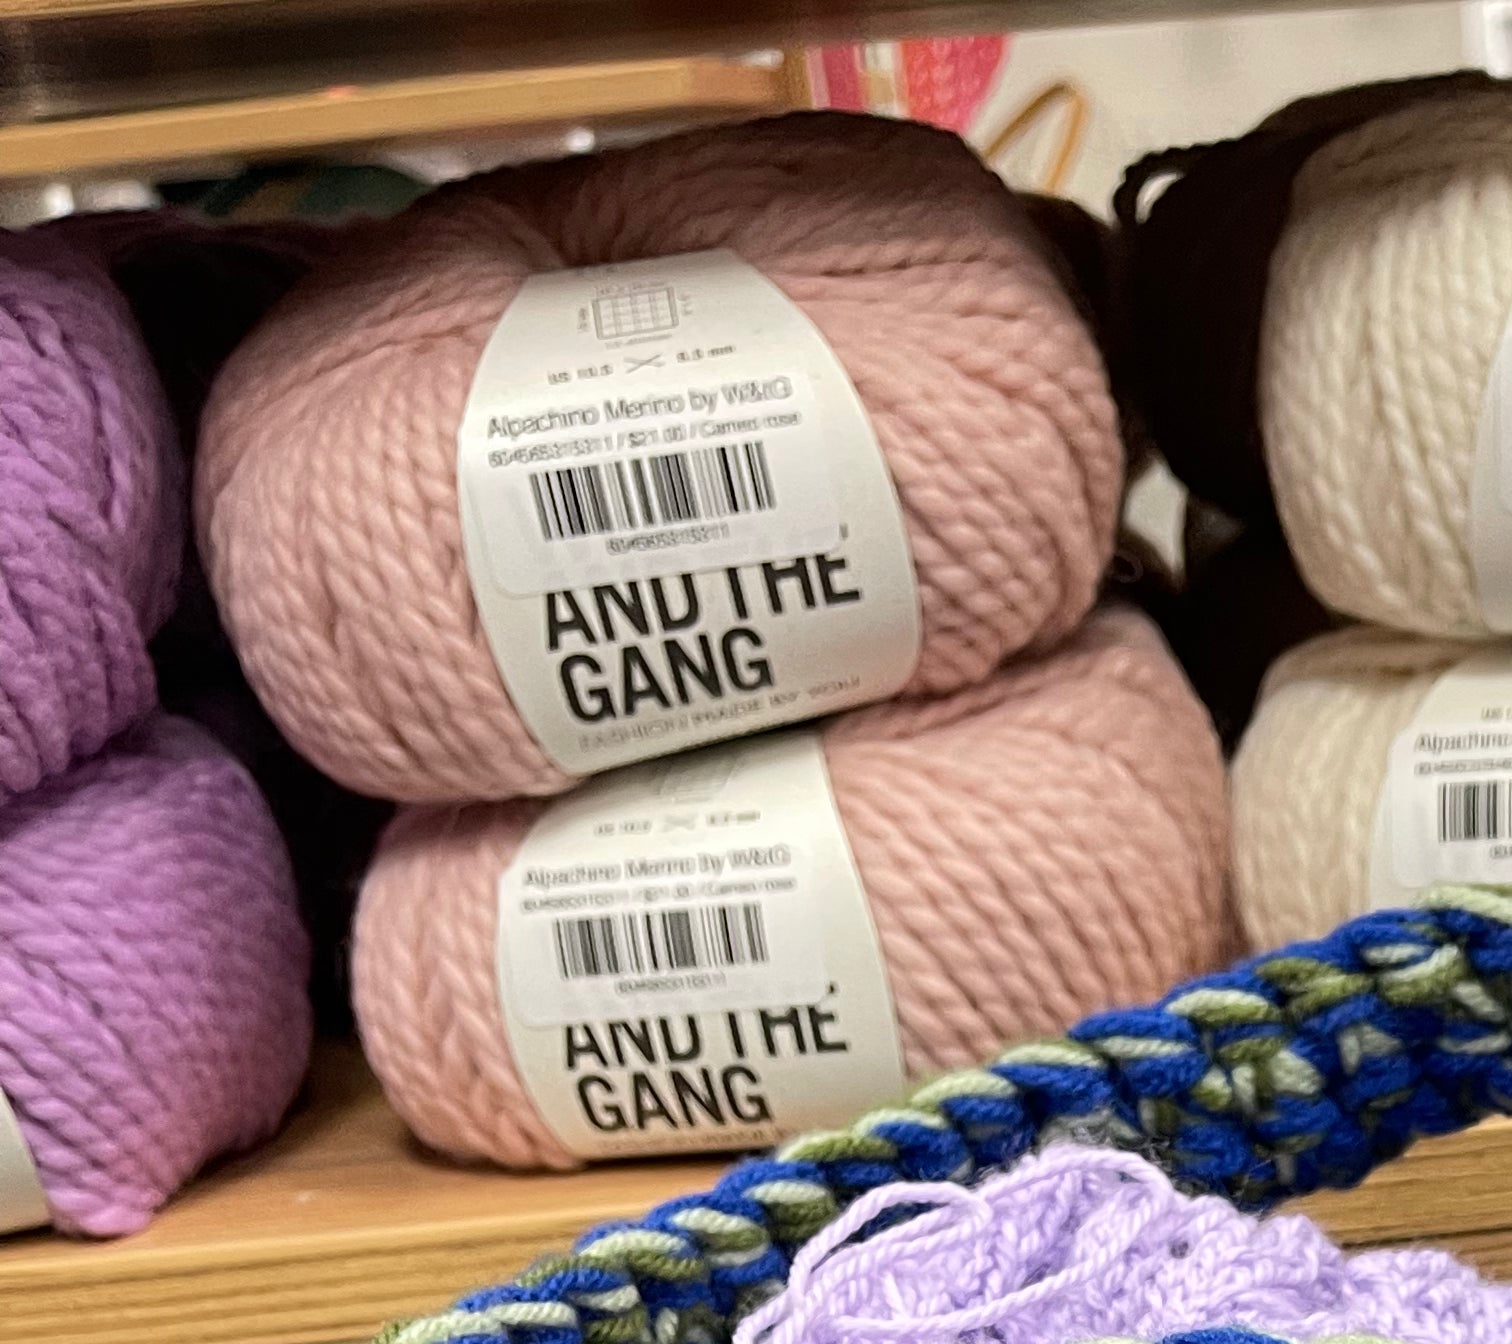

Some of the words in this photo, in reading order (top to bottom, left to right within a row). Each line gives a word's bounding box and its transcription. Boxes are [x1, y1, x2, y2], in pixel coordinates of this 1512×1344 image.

[487, 403, 600, 440] Alpachino
[603, 392, 686, 423] Merino
[688, 386, 718, 414] by
[545, 572, 701, 652] AND
[725, 553, 862, 620] THE
[559, 627, 774, 723] GANG
[564, 1011, 701, 1071] AND
[576, 1064, 774, 1133] GANG
